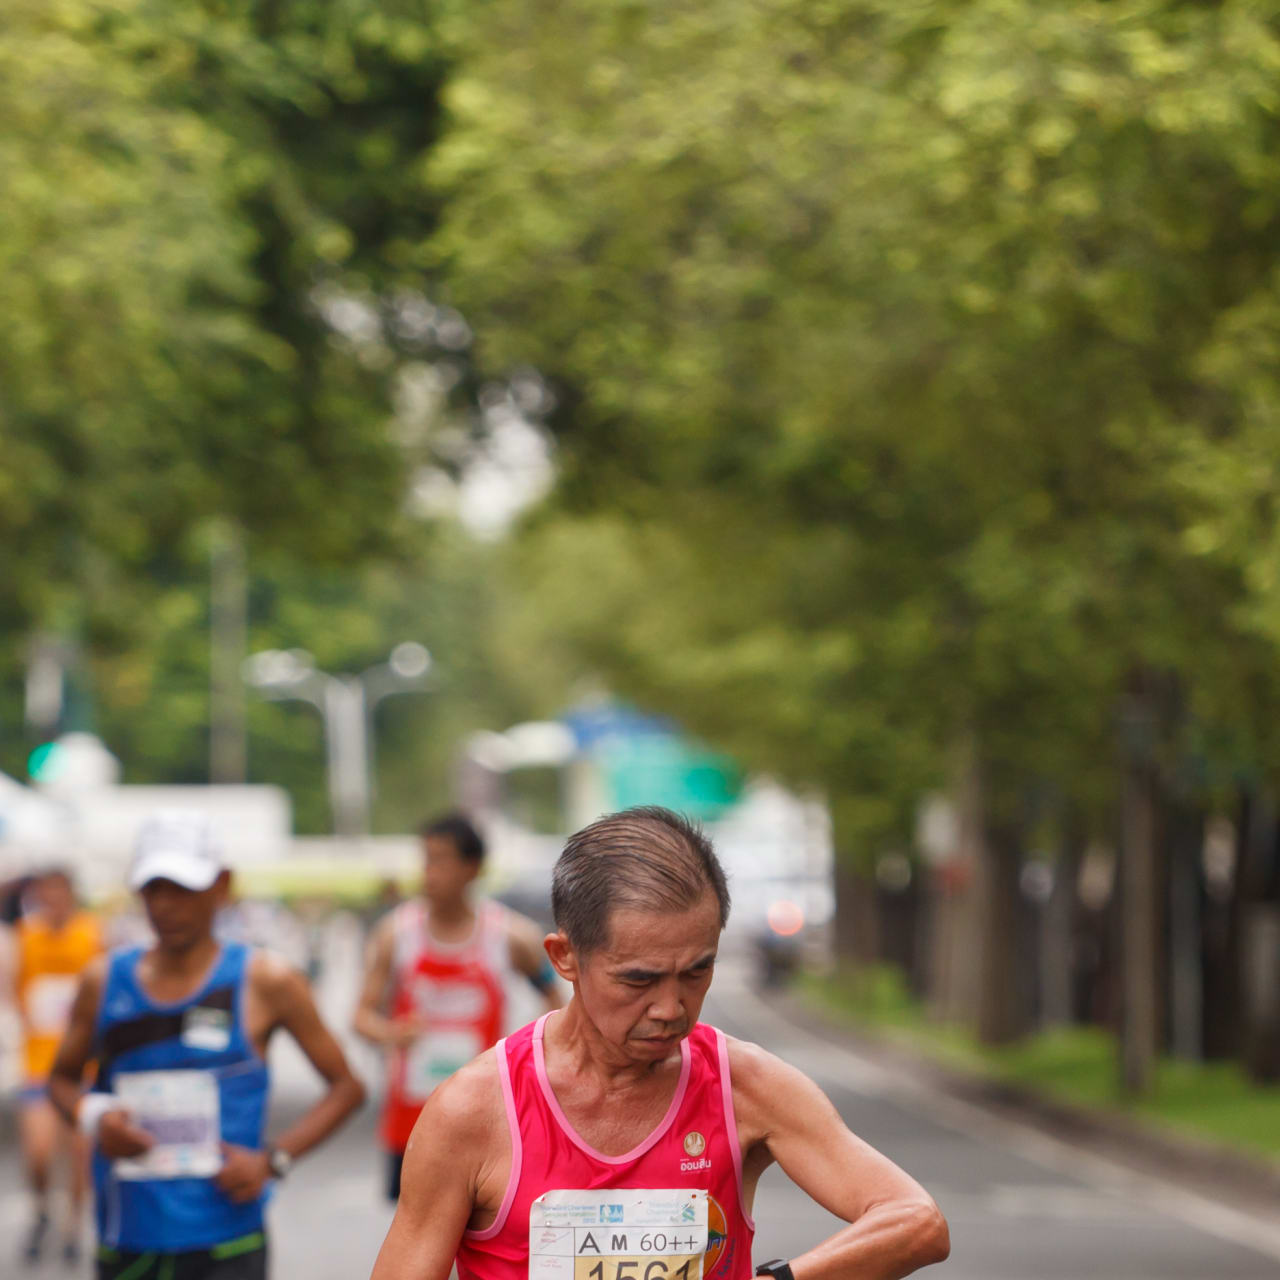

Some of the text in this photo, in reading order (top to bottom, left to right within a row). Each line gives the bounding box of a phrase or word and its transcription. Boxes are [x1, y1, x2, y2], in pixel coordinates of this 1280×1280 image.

[578, 1231, 600, 1254] A
[611, 1234, 628, 1251] M
[640, 1233, 699, 1252] 60++
